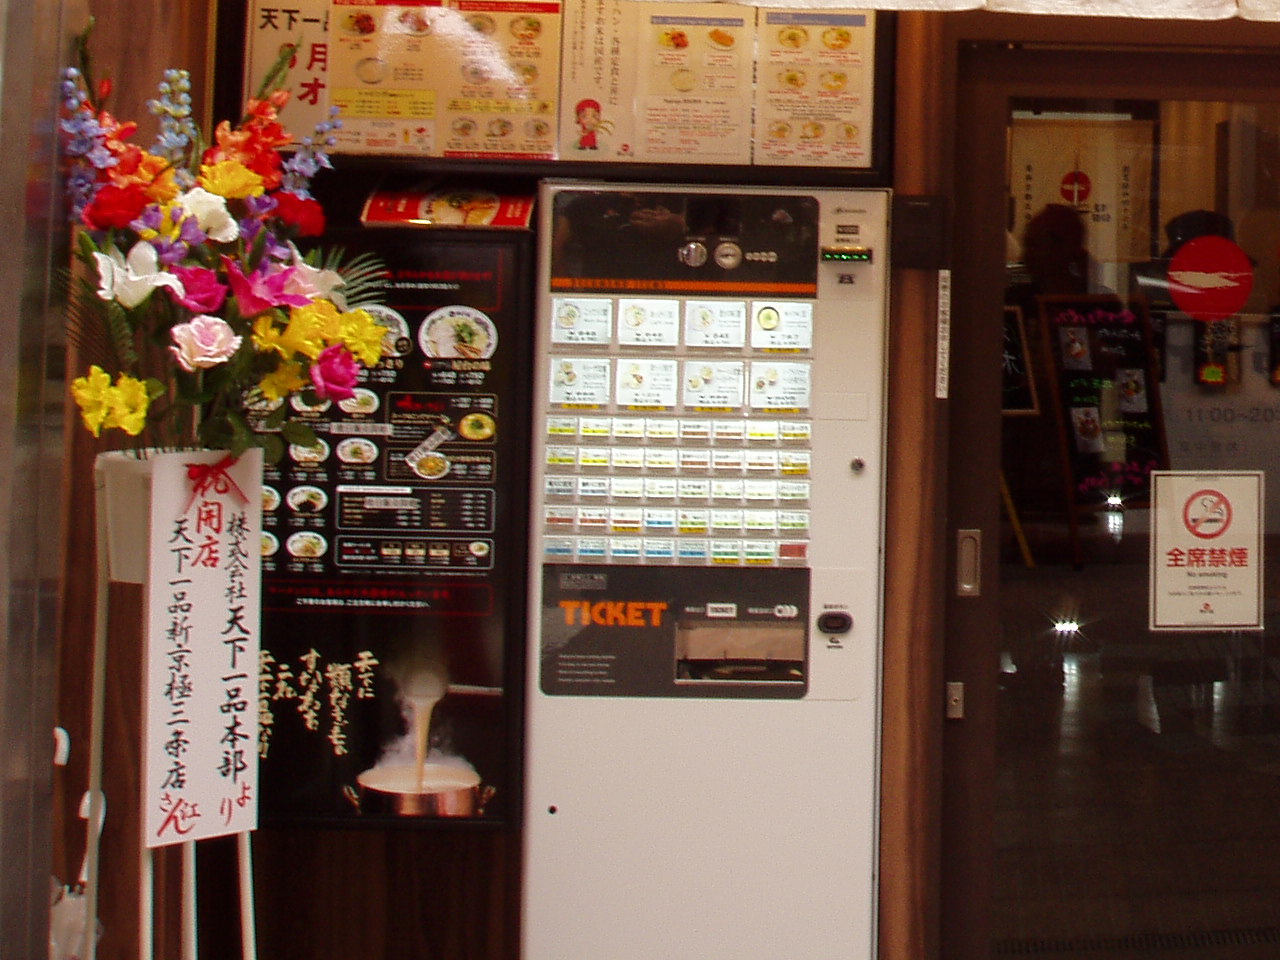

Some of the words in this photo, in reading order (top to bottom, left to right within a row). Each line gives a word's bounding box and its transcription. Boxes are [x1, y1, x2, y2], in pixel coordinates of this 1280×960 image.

[259, 7, 329, 31] 天下一
[1166, 547, 1250, 569] 全席禁煙
[558, 599, 669, 627] TICKET
[161, 518, 195, 791] 天下一品新京極三条店
[216, 511, 252, 785] 株式会社天下一品本部
